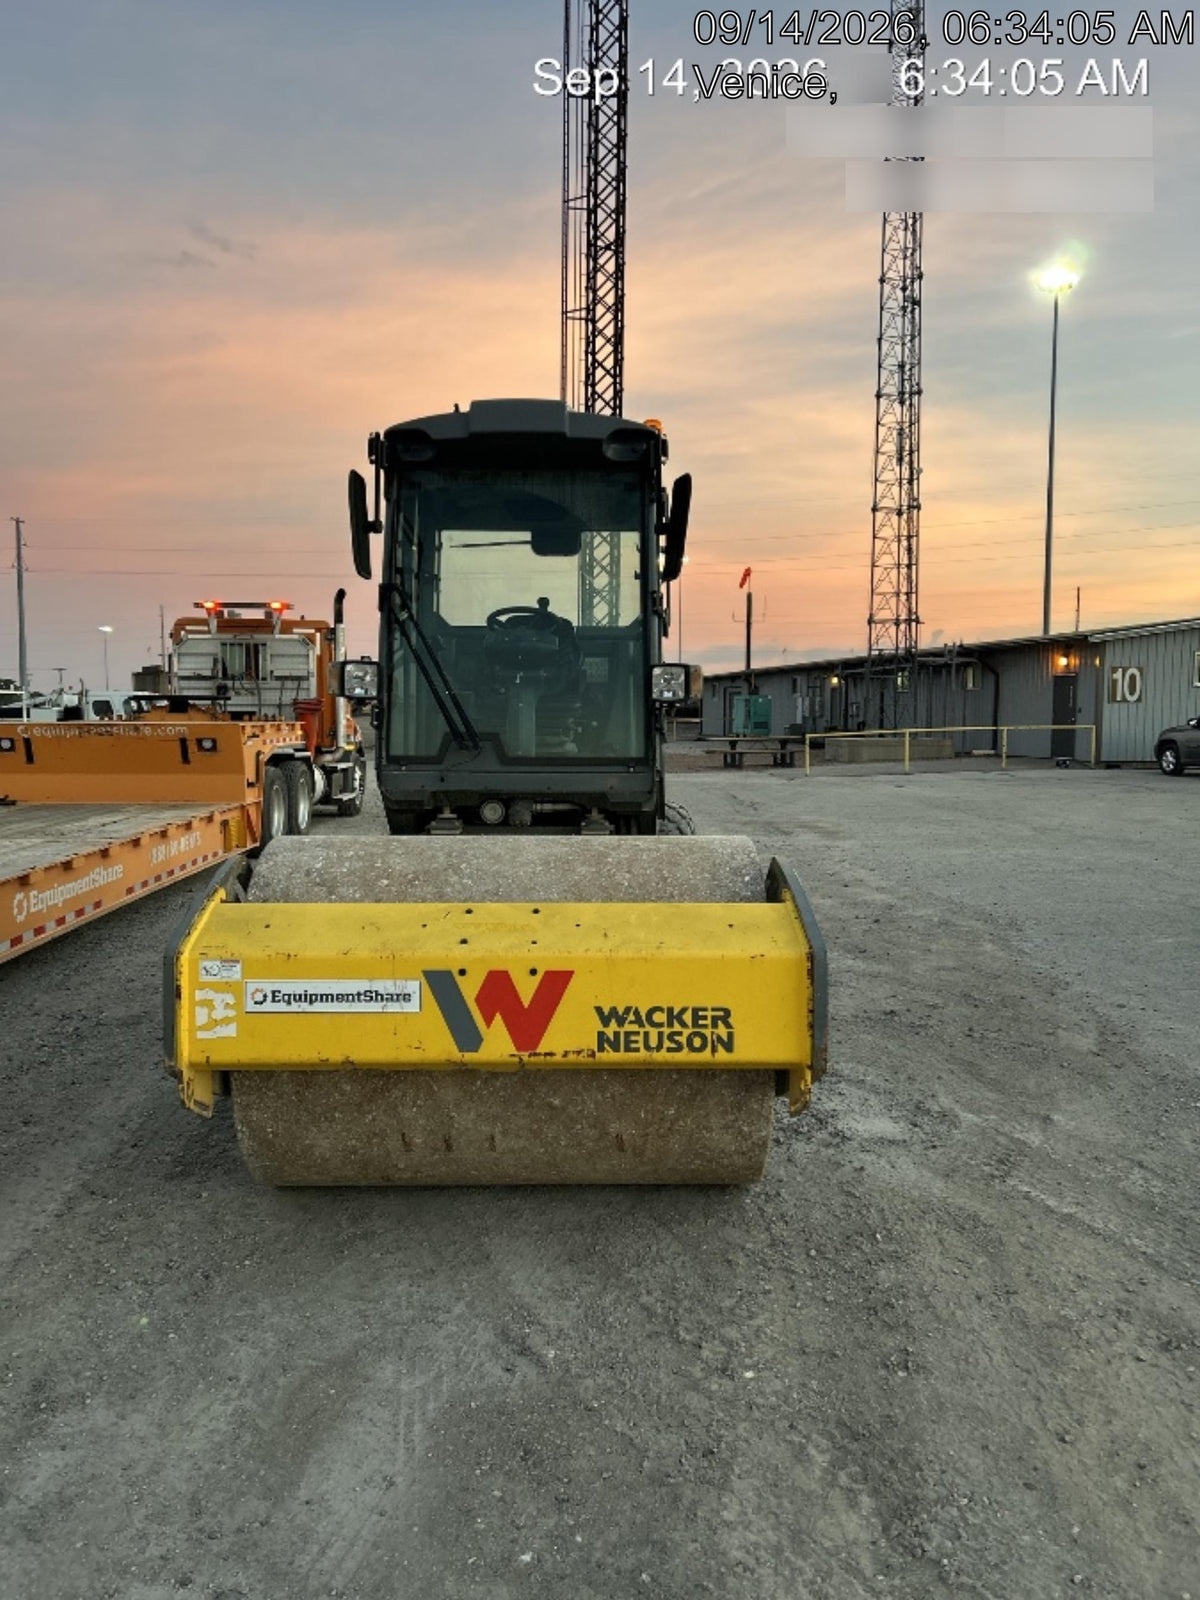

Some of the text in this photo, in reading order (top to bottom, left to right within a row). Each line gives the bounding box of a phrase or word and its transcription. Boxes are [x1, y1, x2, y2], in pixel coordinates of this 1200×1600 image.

[1112, 667, 1142, 702] 10
[29, 863, 124, 913] EquipmentShare
[270, 989, 412, 1006] EquipmentShare
[594, 1006, 734, 1029] WACKER
[597, 1031, 734, 1053] NEUSON
